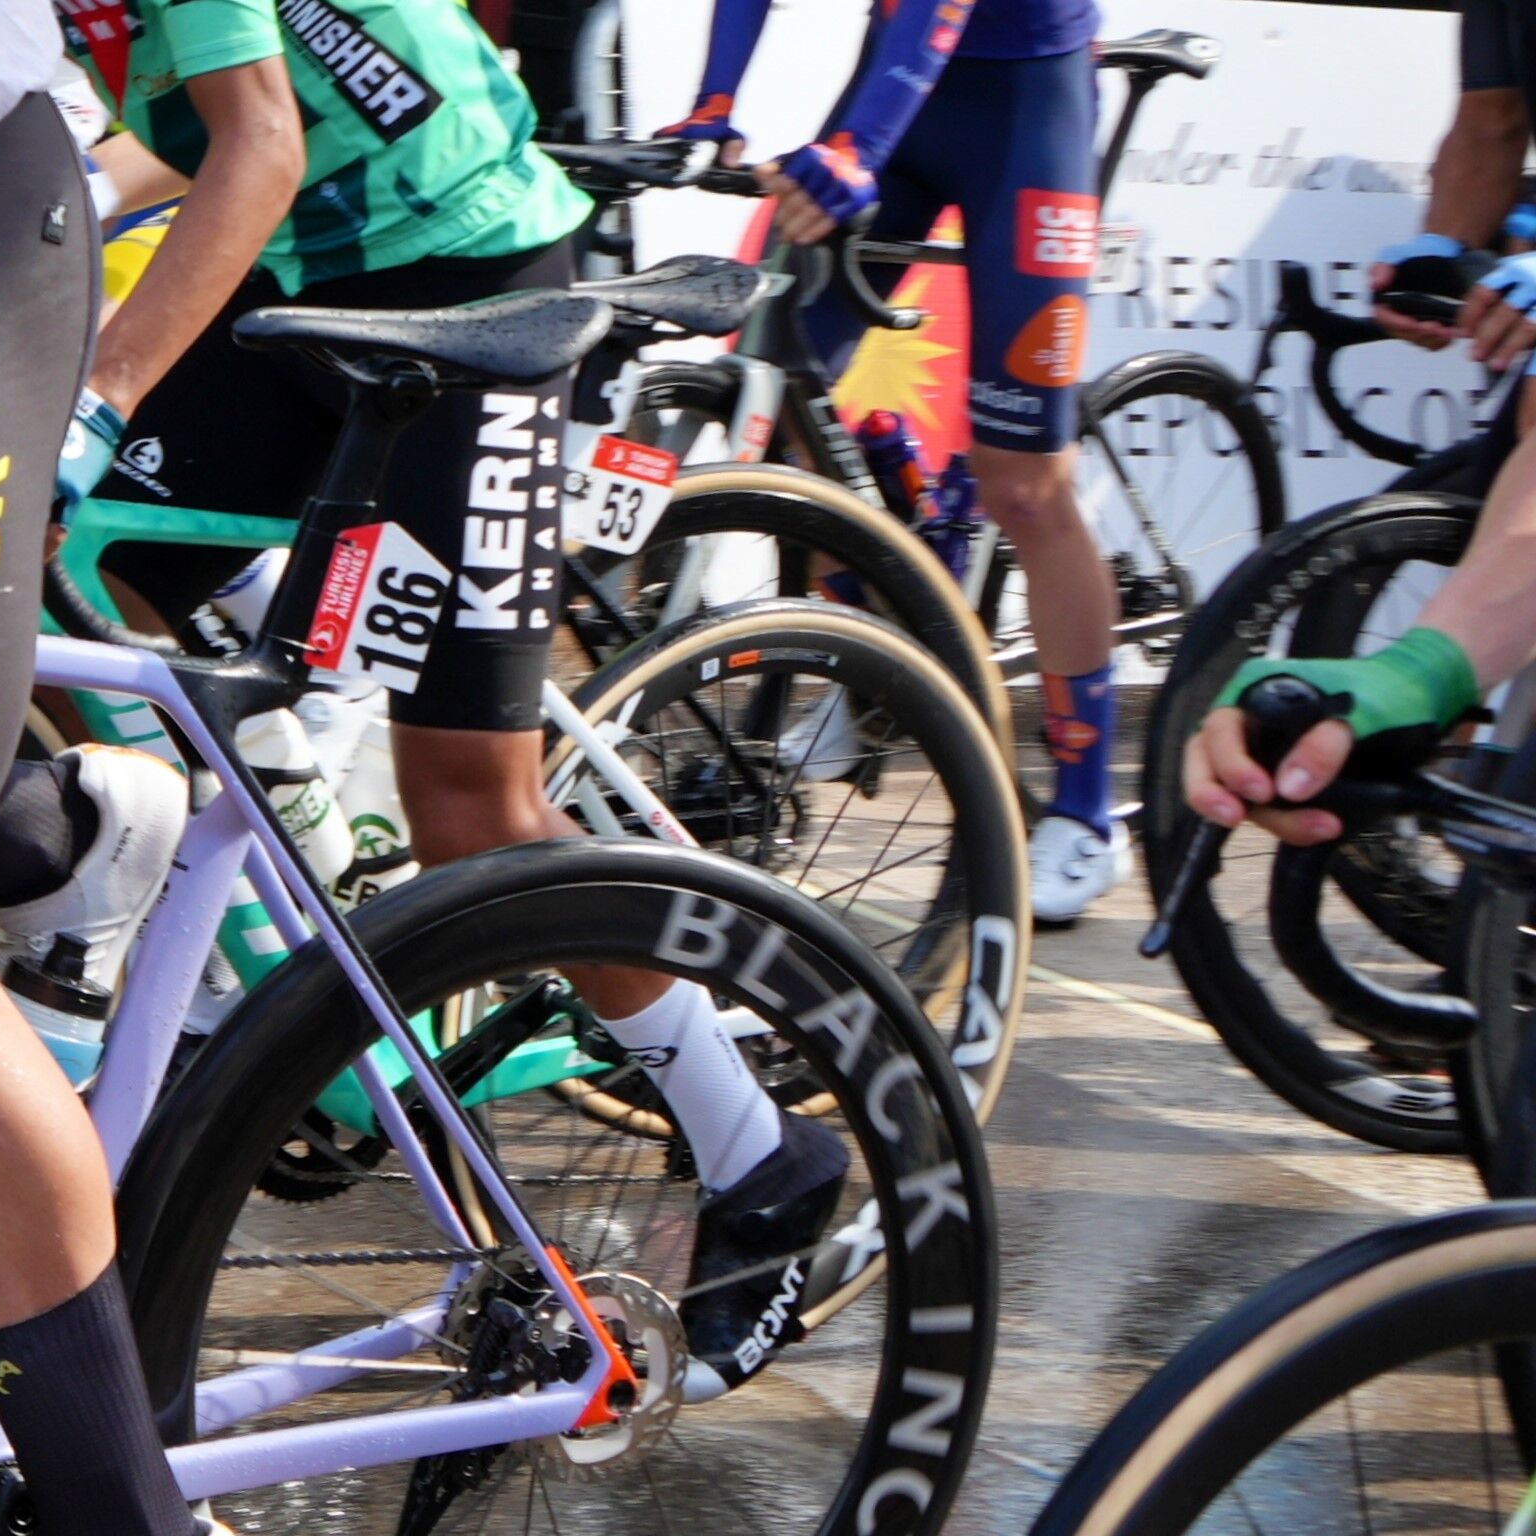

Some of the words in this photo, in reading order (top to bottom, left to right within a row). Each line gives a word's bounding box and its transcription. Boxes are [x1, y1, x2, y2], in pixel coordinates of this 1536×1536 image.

[455, 391, 539, 631] KERN
[528, 394, 561, 630] PHARMA
[597, 482, 644, 542] 53
[336, 547, 370, 621] AIRLINES
[354, 564, 451, 684] 186
[653, 893, 973, 1255] BLACK
[732, 1255, 806, 1376] BONT
